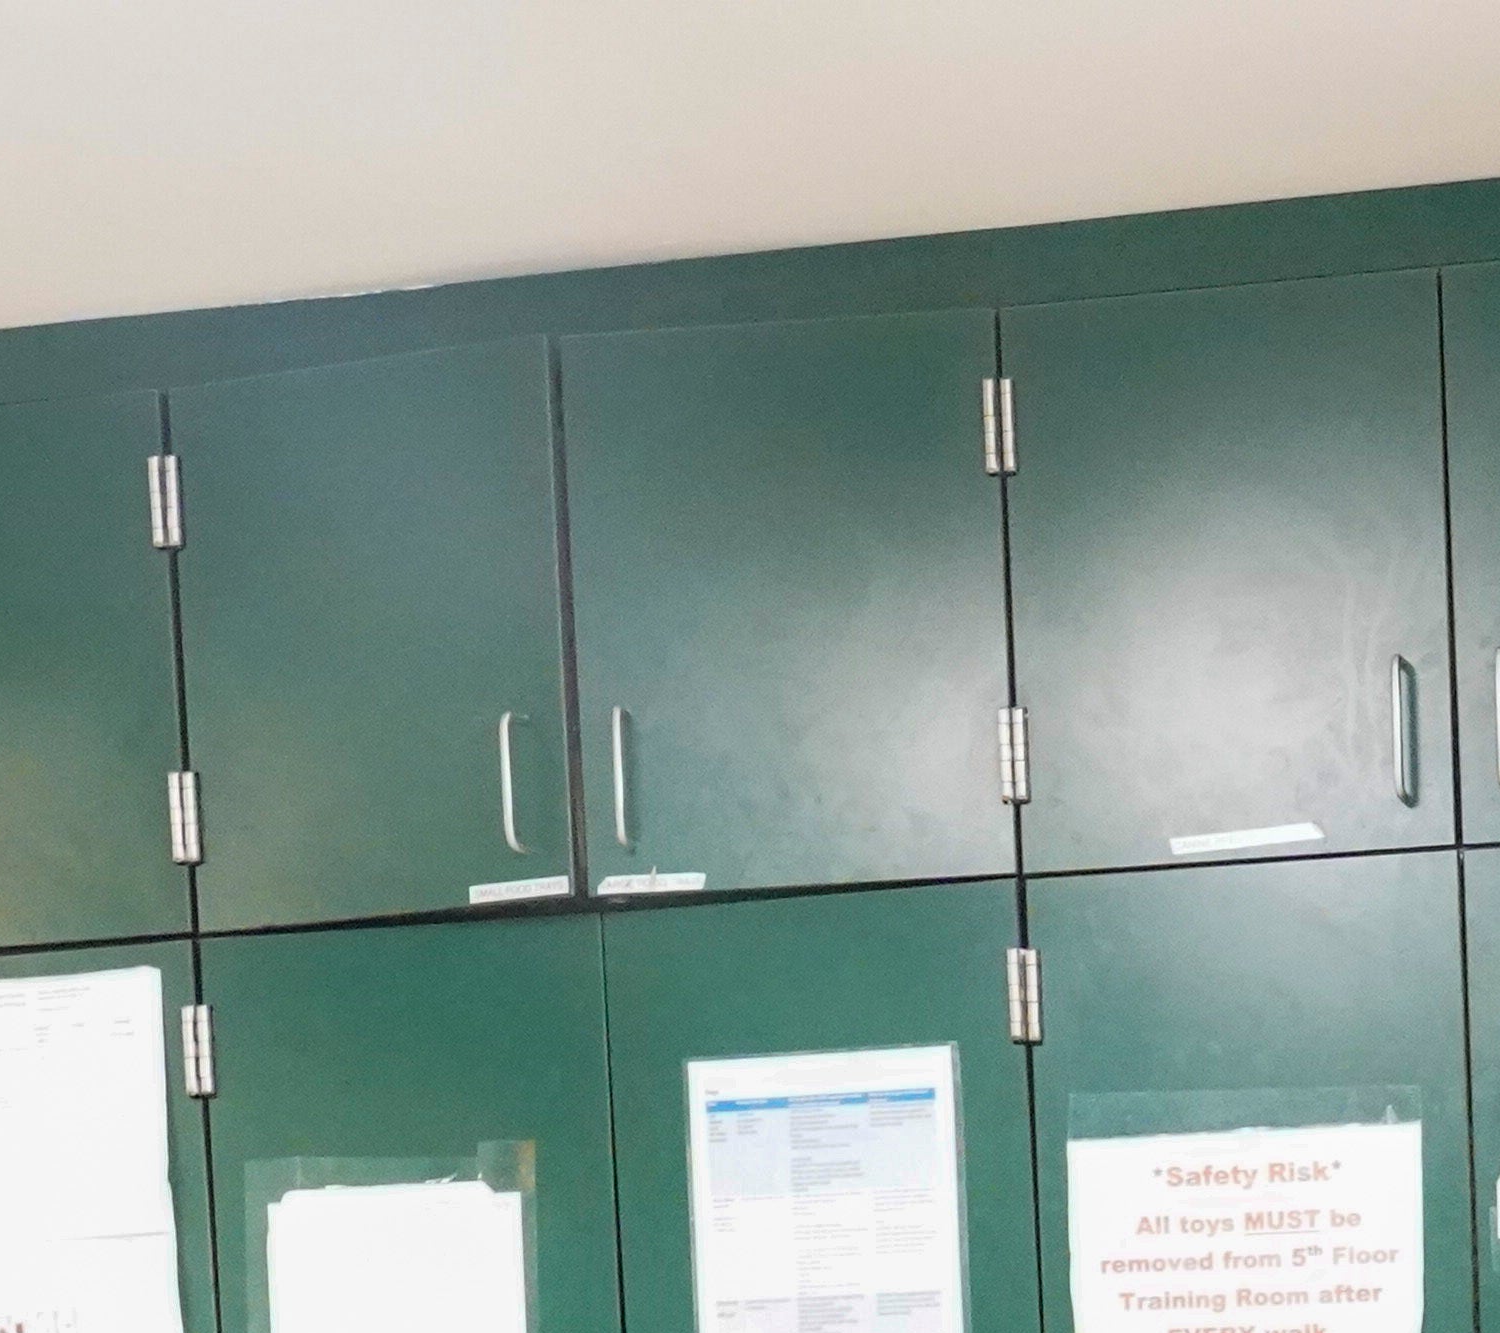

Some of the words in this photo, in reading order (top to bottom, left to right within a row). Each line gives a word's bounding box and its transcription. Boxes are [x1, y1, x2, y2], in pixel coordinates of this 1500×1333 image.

[1135, 1215, 1170, 1235] All
[1179, 1216, 1235, 1238] toys
[1244, 1209, 1320, 1231] MUST
[1329, 1208, 1361, 1229] be
[1100, 1252, 1214, 1275] removed
[1223, 1251, 1282, 1269] from
[1291, 1246, 1324, 1267] 5th
[1332, 1246, 1400, 1265] Floor
[1118, 1290, 1227, 1313] Training
[1236, 1287, 1310, 1307] Room
[1319, 1284, 1383, 1304] after
